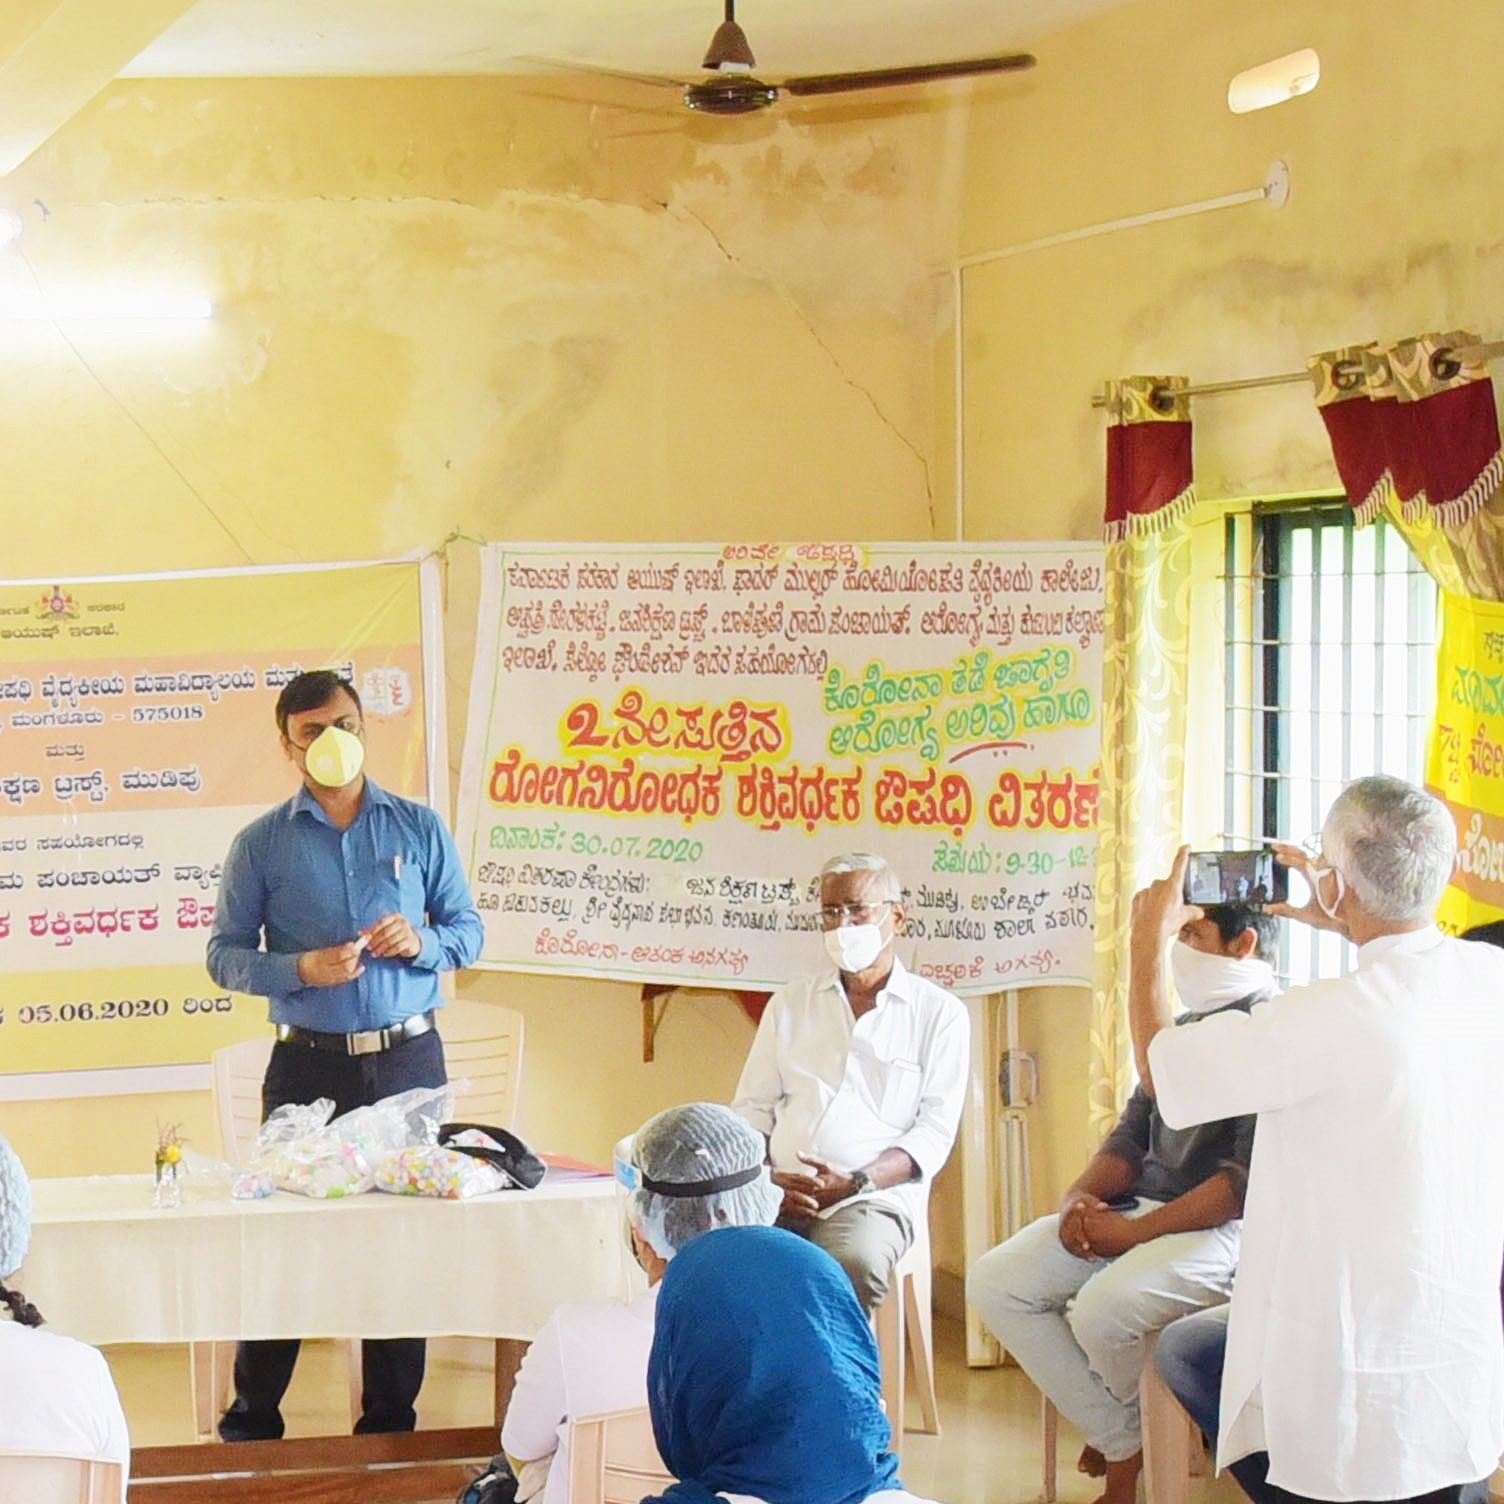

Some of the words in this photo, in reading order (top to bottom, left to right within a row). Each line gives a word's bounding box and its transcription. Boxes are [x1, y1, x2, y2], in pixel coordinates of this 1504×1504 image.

[42, 673, 124, 708] ವೈದ್ಯಕೀಯ
[134, 667, 256, 702] ಮಹಾವಿದ್ಯಾಲಯ
[825, 664, 944, 711] ಕೊರೋನಾ
[951, 651, 989, 694] ತಡೆ
[12, 711, 103, 726] ಮಂಗಳೂರು
[132, 704, 203, 722] 575018
[829, 705, 940, 761] ಆರೋಗ್ಯ
[946, 695, 1017, 739] ಅರಿವು
[1023, 688, 1088, 729] ಹಾಗೂ
[46, 745, 85, 761] ಮತ್ತು
[122, 768, 200, 793] ಮುಡಿಪು
[490, 749, 723, 821] ರೋಗನಿರೋಧಕ
[737, 763, 863, 832] ಶಕ್ತಿವರ್ಧಕ
[875, 766, 972, 838] ಔಷಧಿ
[36, 834, 145, 852] ಸಹಯೋಗದಲ್ಲಿ
[570, 831, 704, 863] 30.07.2020
[37, 863, 160, 889] ಪಂಚಾಯತ್
[28, 903, 159, 946] ಶಕ್ತಿವರ್ಧಕ
[18, 1000, 169, 1026] 05.06.2020
[183, 995, 233, 1015] ರಿಂದ
